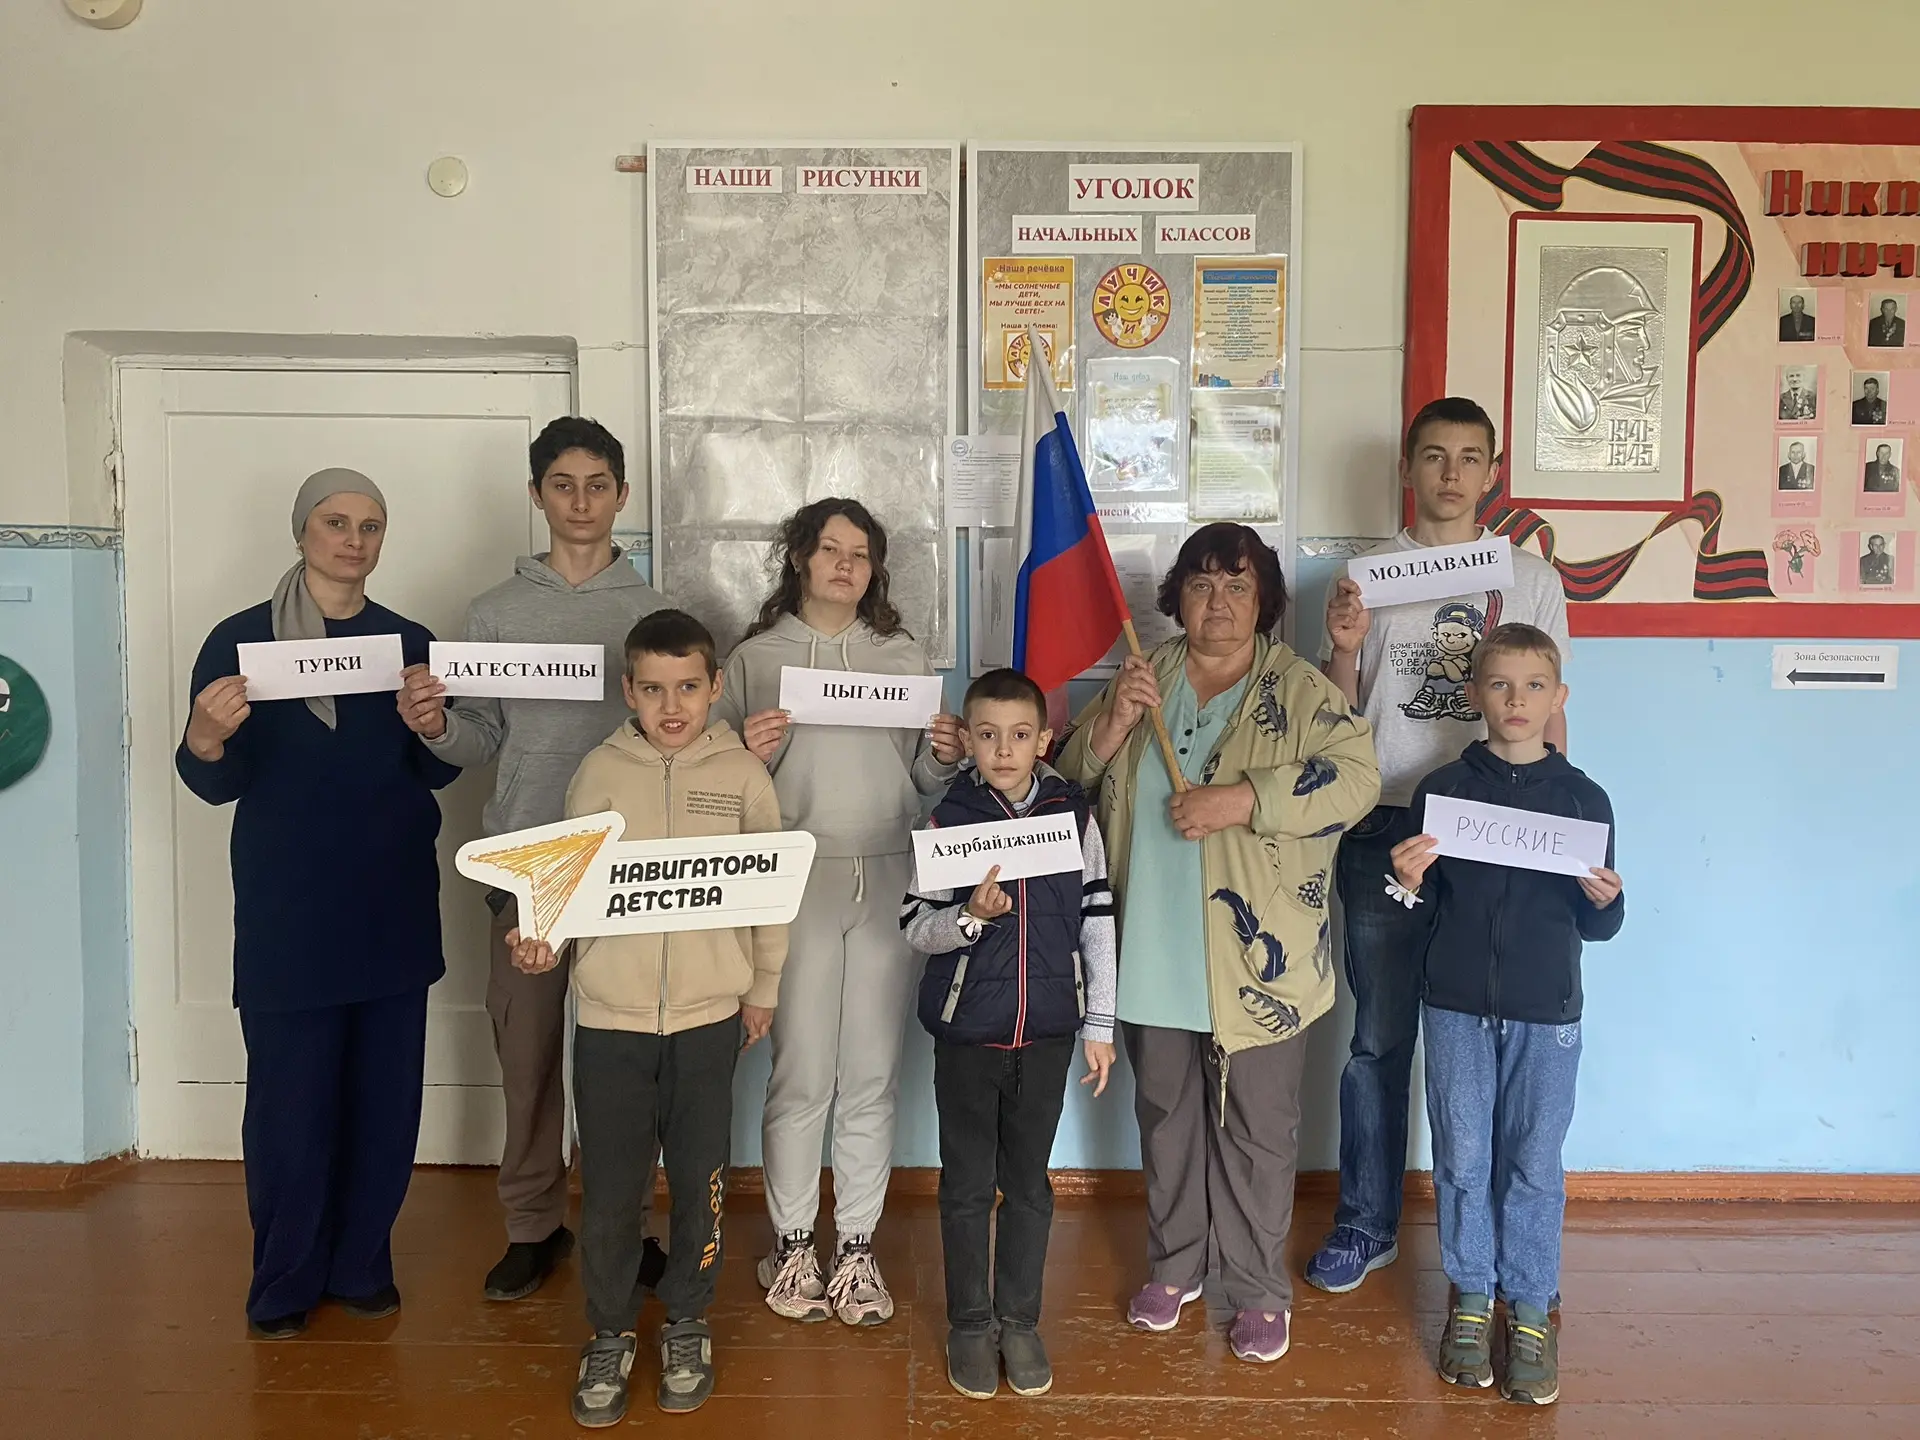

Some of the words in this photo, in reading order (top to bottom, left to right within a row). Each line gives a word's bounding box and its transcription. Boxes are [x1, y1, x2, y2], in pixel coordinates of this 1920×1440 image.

[694, 168, 772, 186] НАШИ
[802, 169, 921, 188] РИСУНКИ
[1073, 178, 1194, 200] УГОЛОК
[1017, 227, 1138, 242] НАЧАЛЬНЫХ
[1160, 227, 1251, 242] КЛАССОВ
[1000, 264, 1025, 273] Наша
[1027, 264, 1065, 274] речёвка
[1800, 242, 1920, 278] нич
[1368, 550, 1499, 582] МОЛДАВАНЕ
[1390, 641, 1435, 650] SOMETIMES
[1390, 649, 1408, 658] IT'S
[1411, 649, 1439, 657] HARD
[295, 655, 362, 675] ТУРКИ
[1390, 658, 1404, 667] TO
[1407, 658, 1420, 667] BE
[1421, 659, 1430, 667] A
[1794, 651, 1816, 661] Зона
[1818, 652, 1880, 662] безопасности
[445, 661, 597, 679] ДАГЕСТАНЦЫ
[822, 683, 909, 701] ЦЫГАНЕ
[931, 829, 1073, 859] Азербайджанцы
[1456, 816, 1567, 855] РУССКИЕ
[609, 852, 779, 885] НАВИГАТОРЫ
[606, 885, 723, 918] ДЕТСТВА
